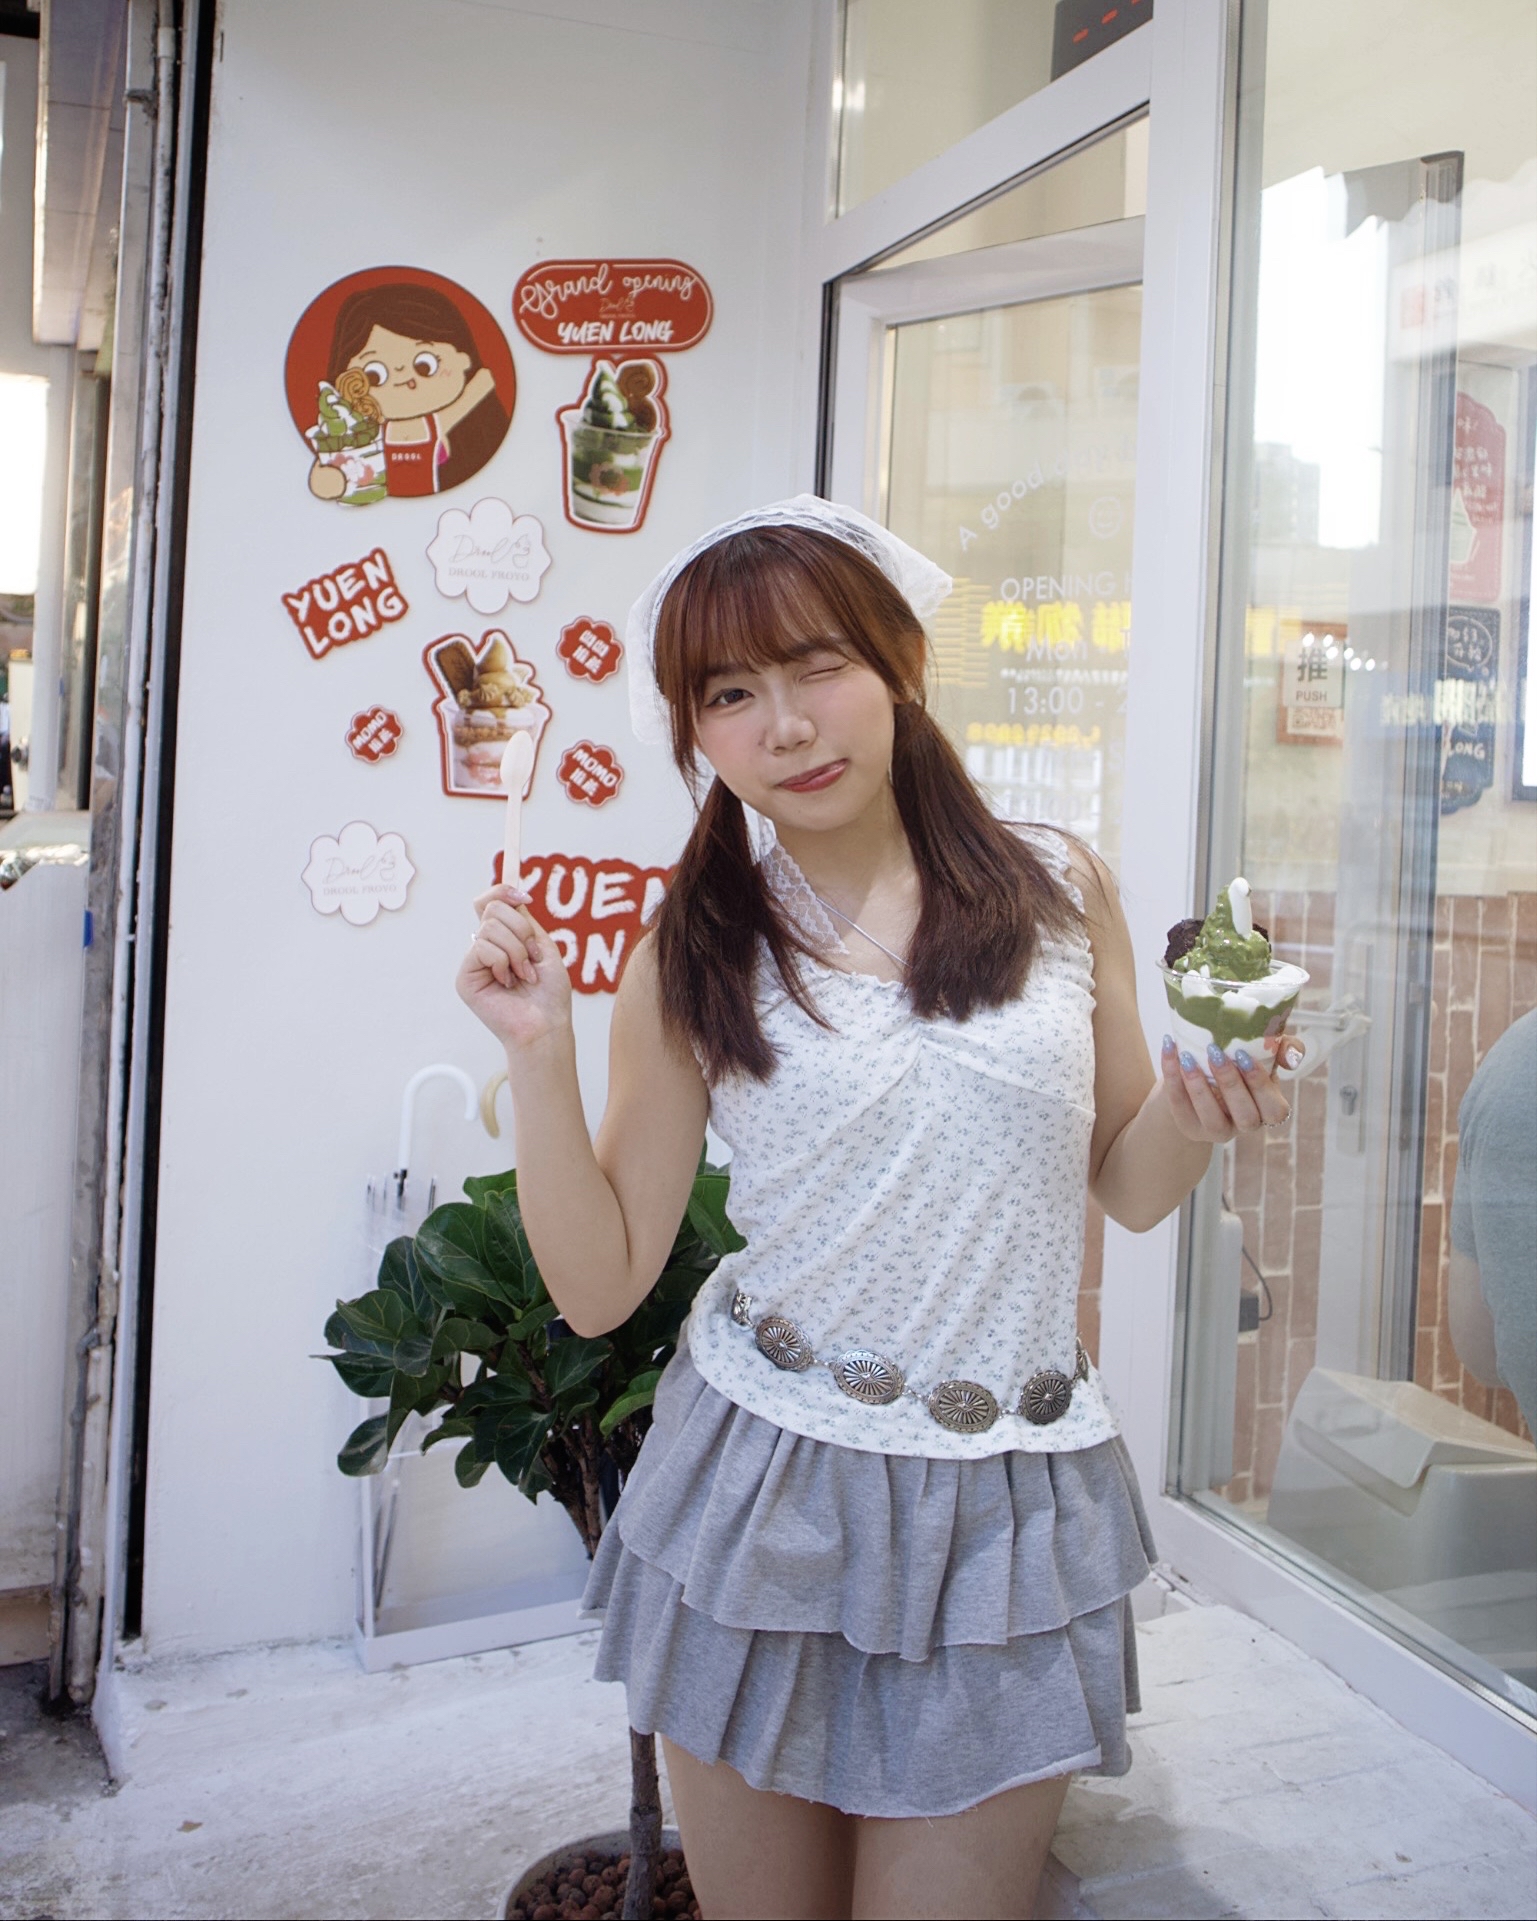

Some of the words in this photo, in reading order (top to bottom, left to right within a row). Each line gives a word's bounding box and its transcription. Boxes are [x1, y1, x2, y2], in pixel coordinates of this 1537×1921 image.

[520, 263, 614, 319] Grand
[622, 273, 697, 300] opening
[557, 320, 615, 344] YUEN
[619, 319, 674, 343] LONG
[391, 452, 422, 461] DROOL
[959, 525, 978, 552] A
[981, 460, 1044, 530] good
[287, 552, 389, 622] YUEN
[448, 567, 487, 578] DROOL
[491, 570, 529, 581] FROYO
[1001, 571, 1116, 603] OPENING
[303, 586, 403, 655] LONG
[1025, 633, 1088, 662] Mon
[1297, 646, 1328, 683] 推
[1008, 686, 1084, 715] 13:00
[1296, 690, 1327, 701] PUSH
[352, 711, 387, 750] MOMO
[572, 748, 619, 788] MOMO
[323, 886, 359, 896] DROOL
[361, 883, 397, 894] FROYO
[549, 928, 625, 985] ON
